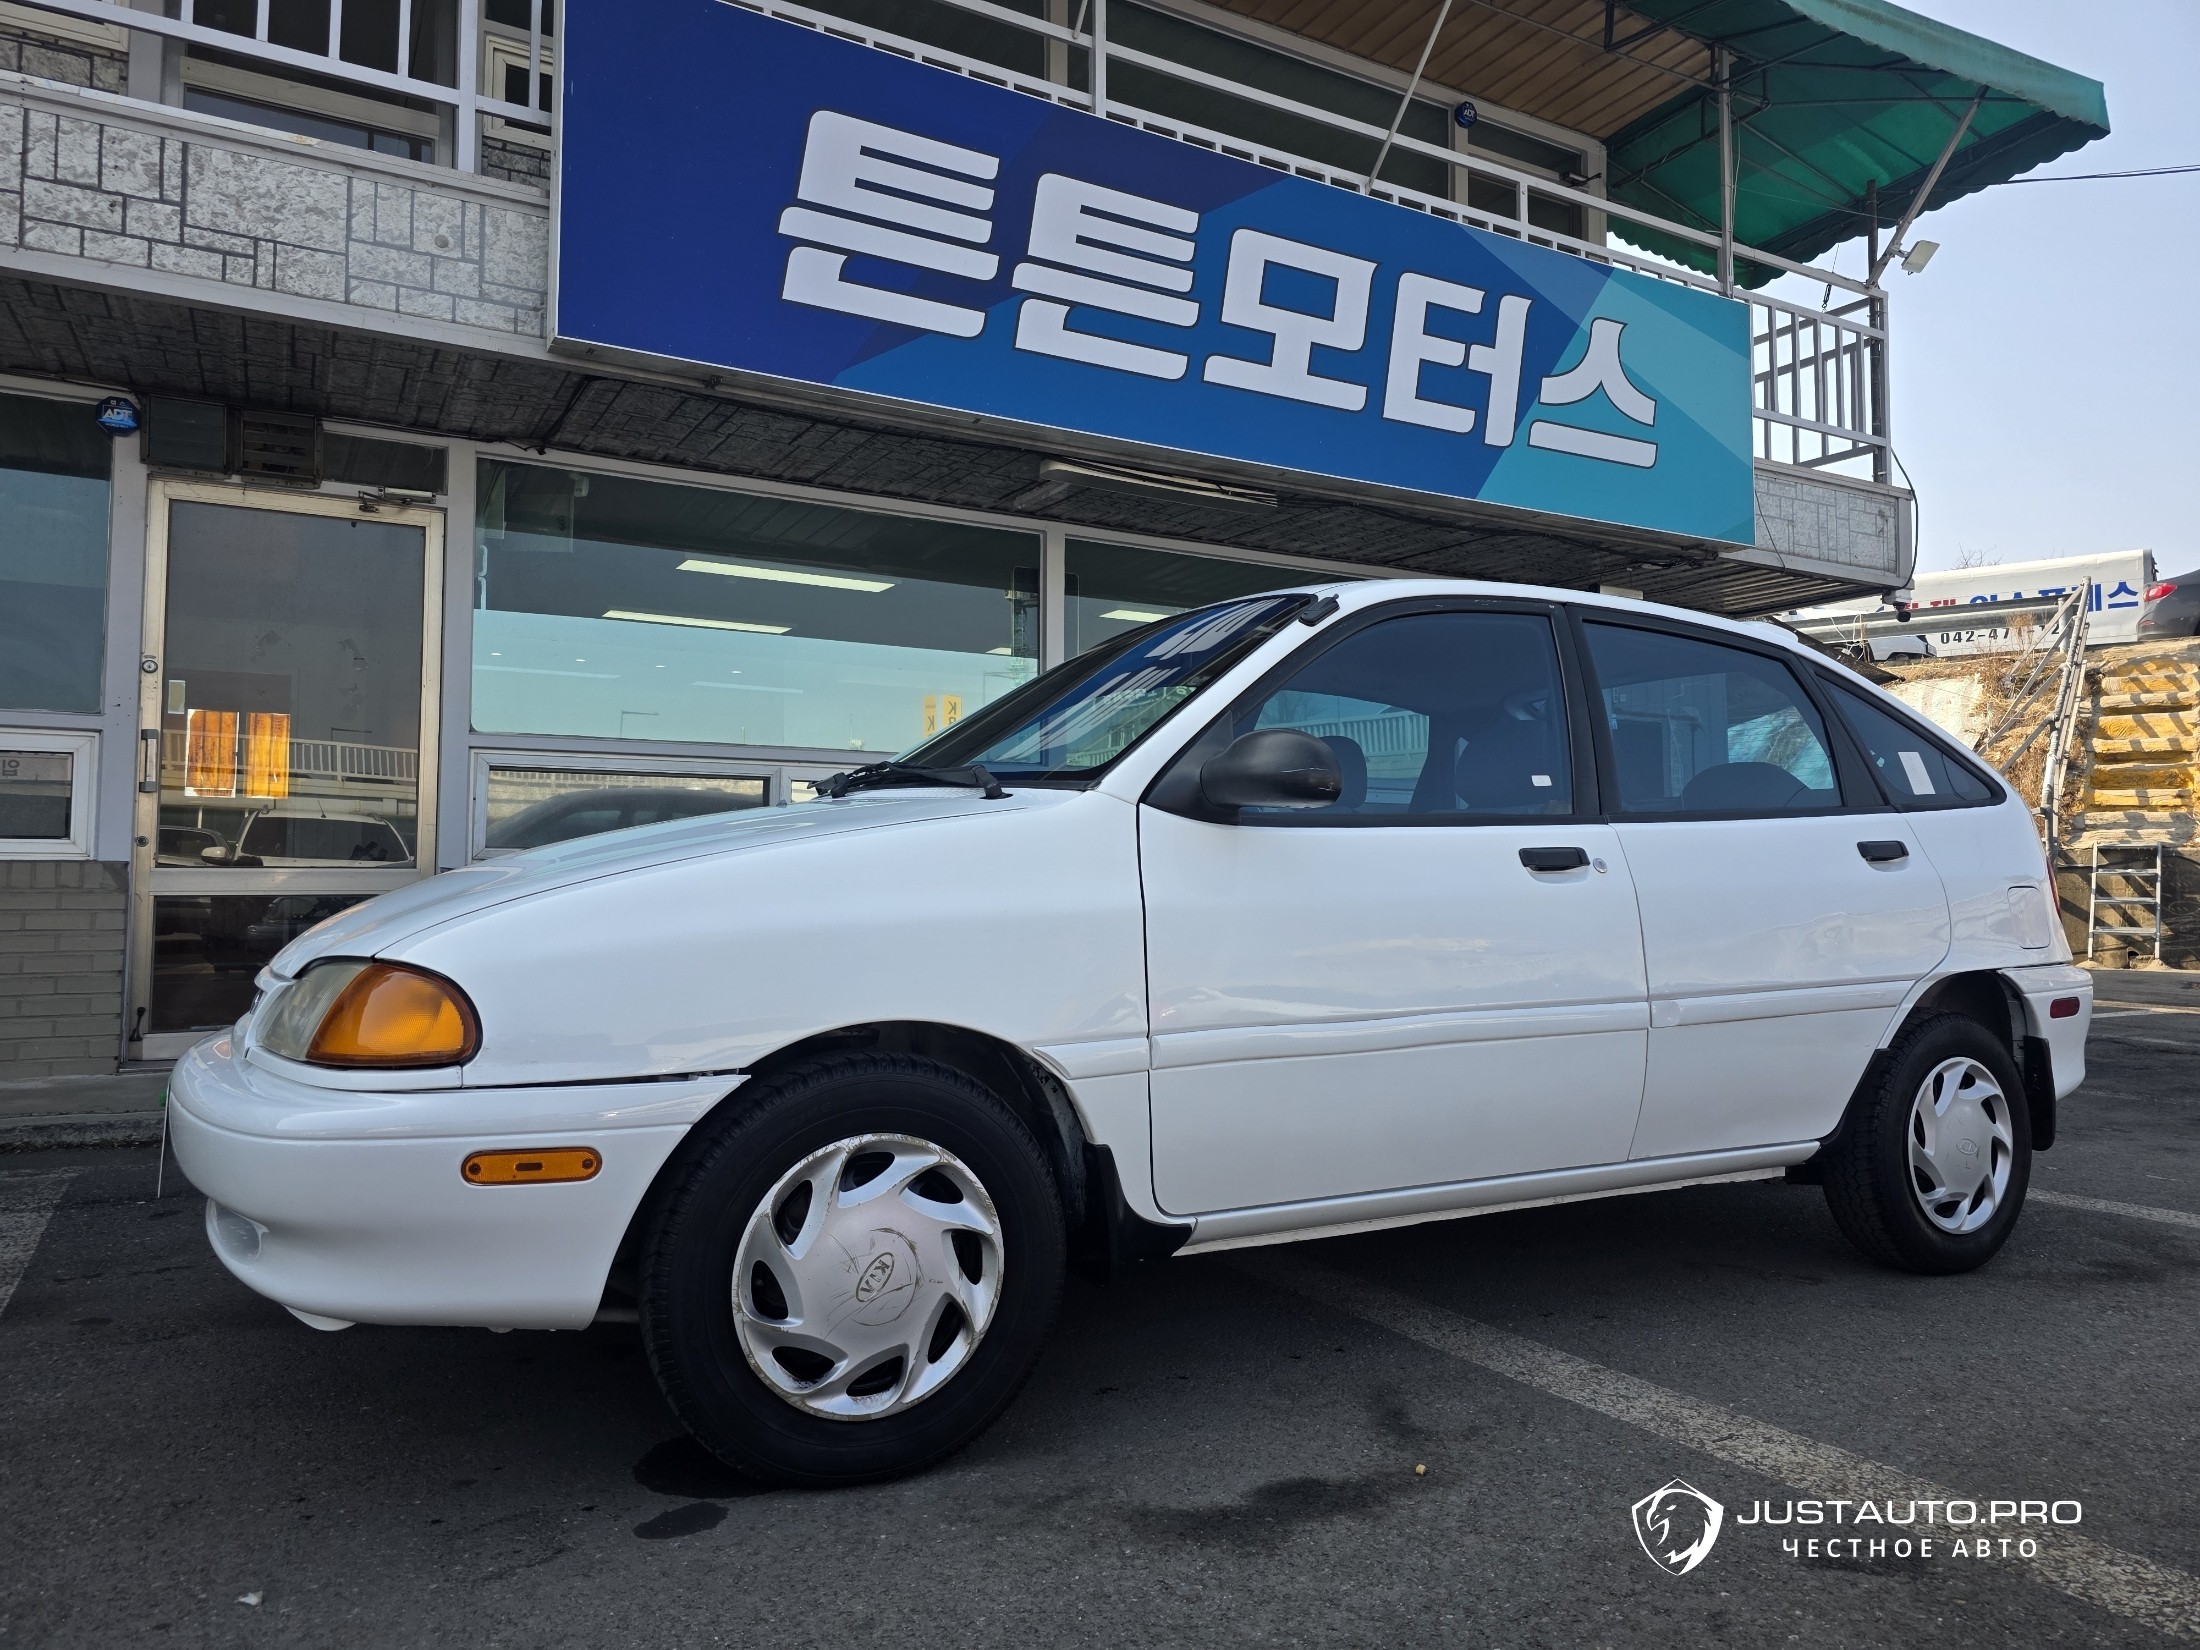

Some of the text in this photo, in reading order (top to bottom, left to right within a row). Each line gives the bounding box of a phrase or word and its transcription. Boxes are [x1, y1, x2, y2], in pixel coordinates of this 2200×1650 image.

[777, 109, 1658, 469] 튼튼모터스
[102, 408, 133, 422] ADT
[859, 1258, 891, 1295] KIA
